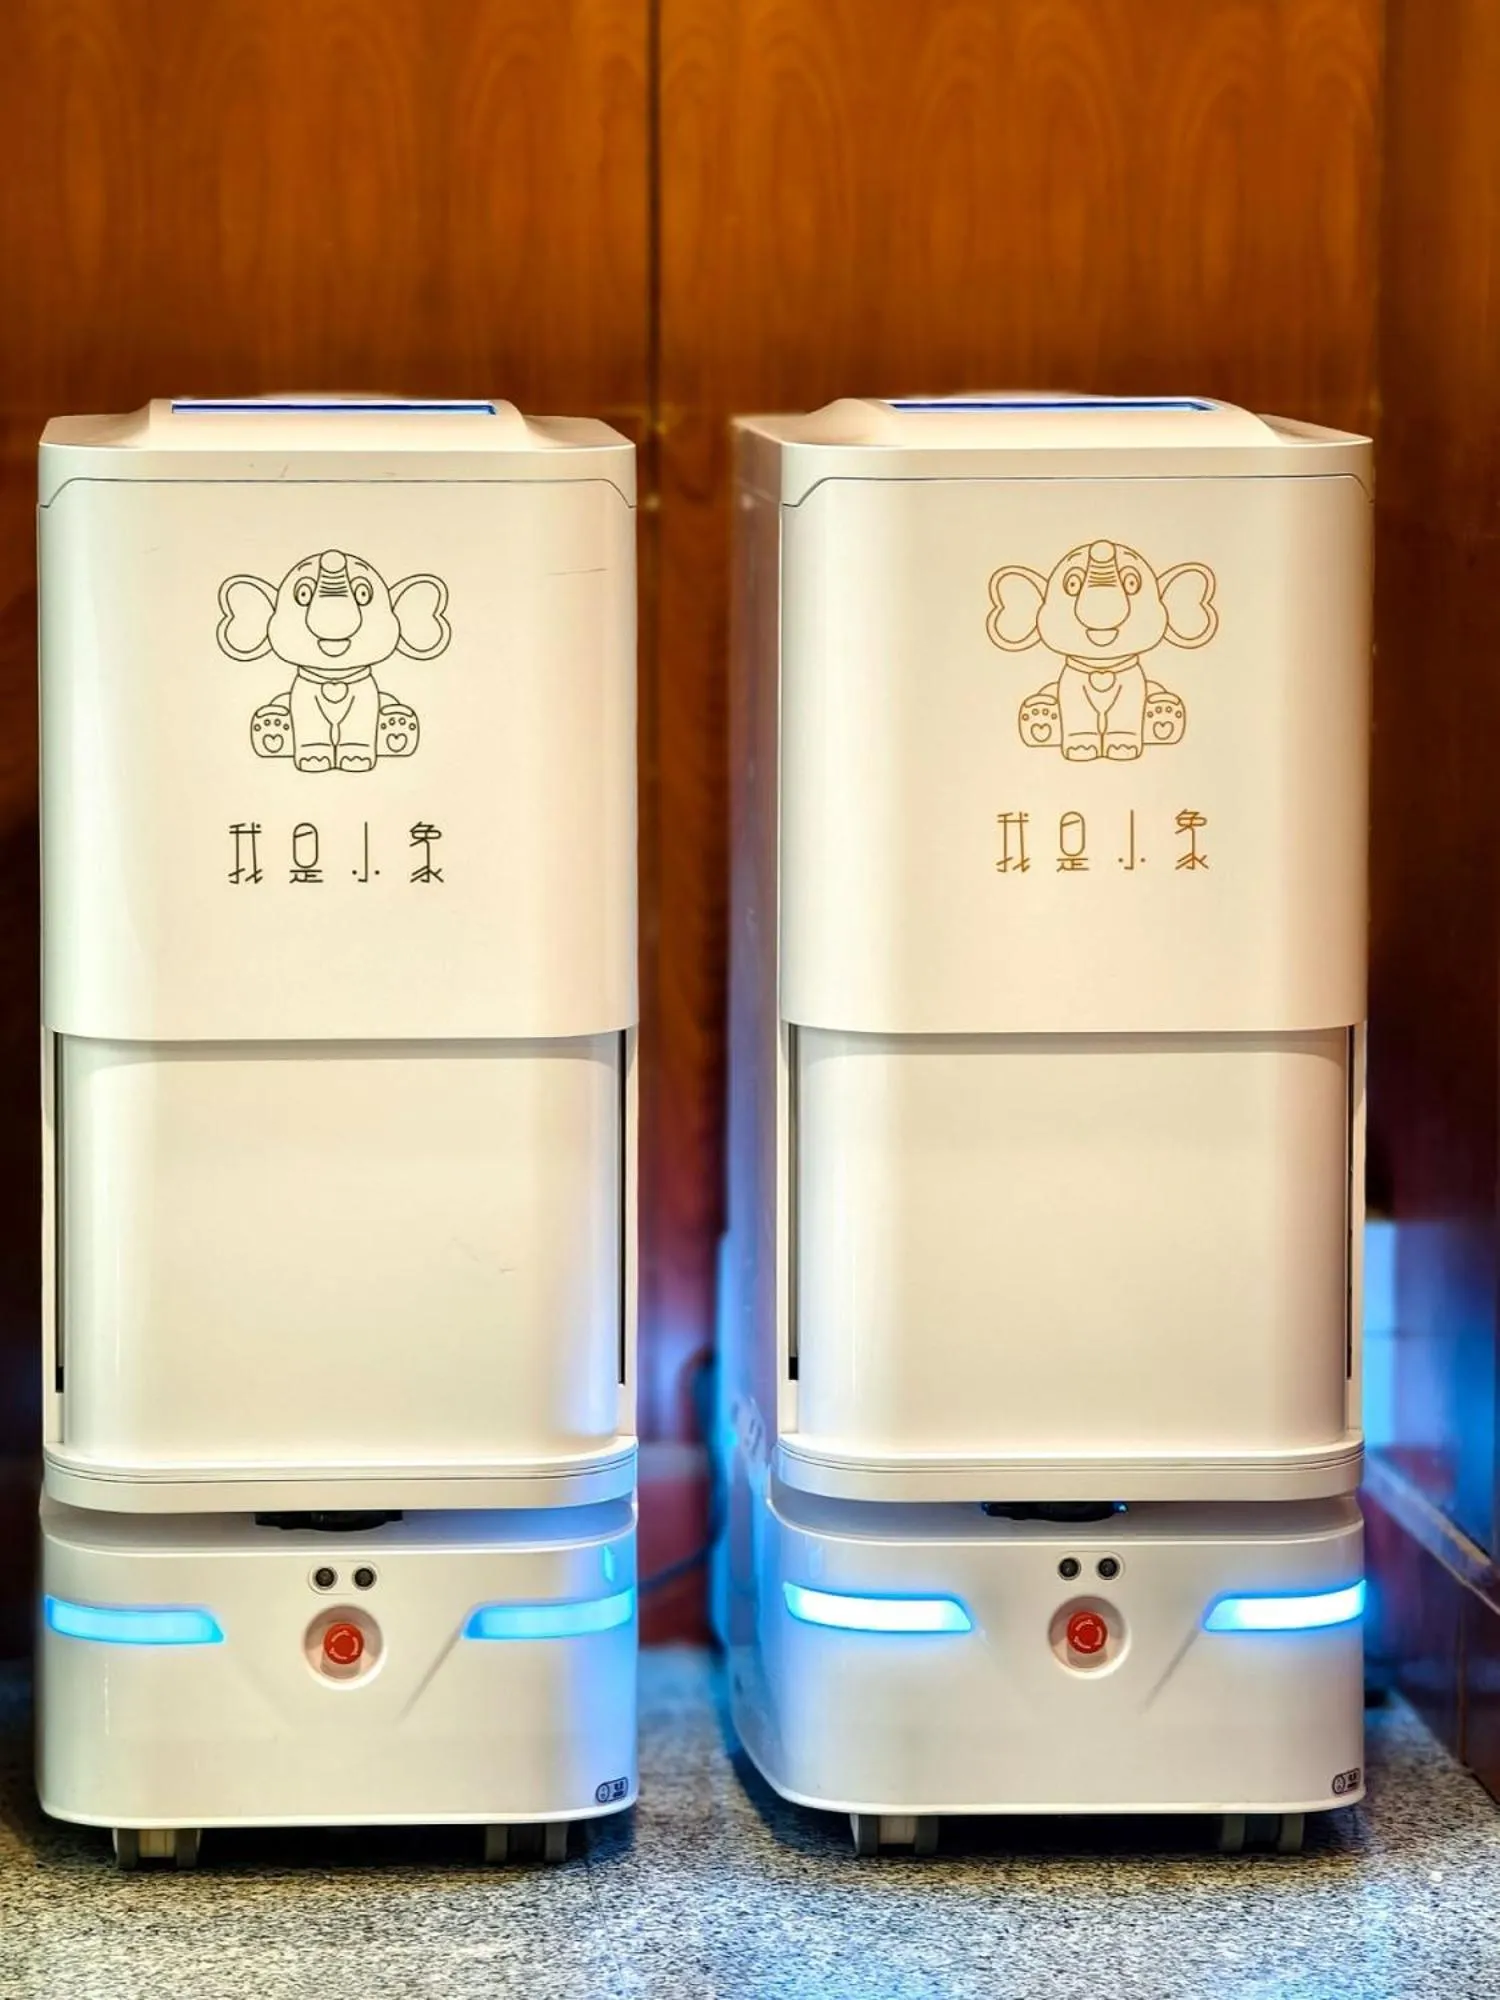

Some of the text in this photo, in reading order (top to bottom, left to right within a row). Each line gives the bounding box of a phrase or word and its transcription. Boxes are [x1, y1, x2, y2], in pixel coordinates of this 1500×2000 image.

[228, 821, 445, 884] 我是小象
[996, 808, 1210, 873] 我是小象
